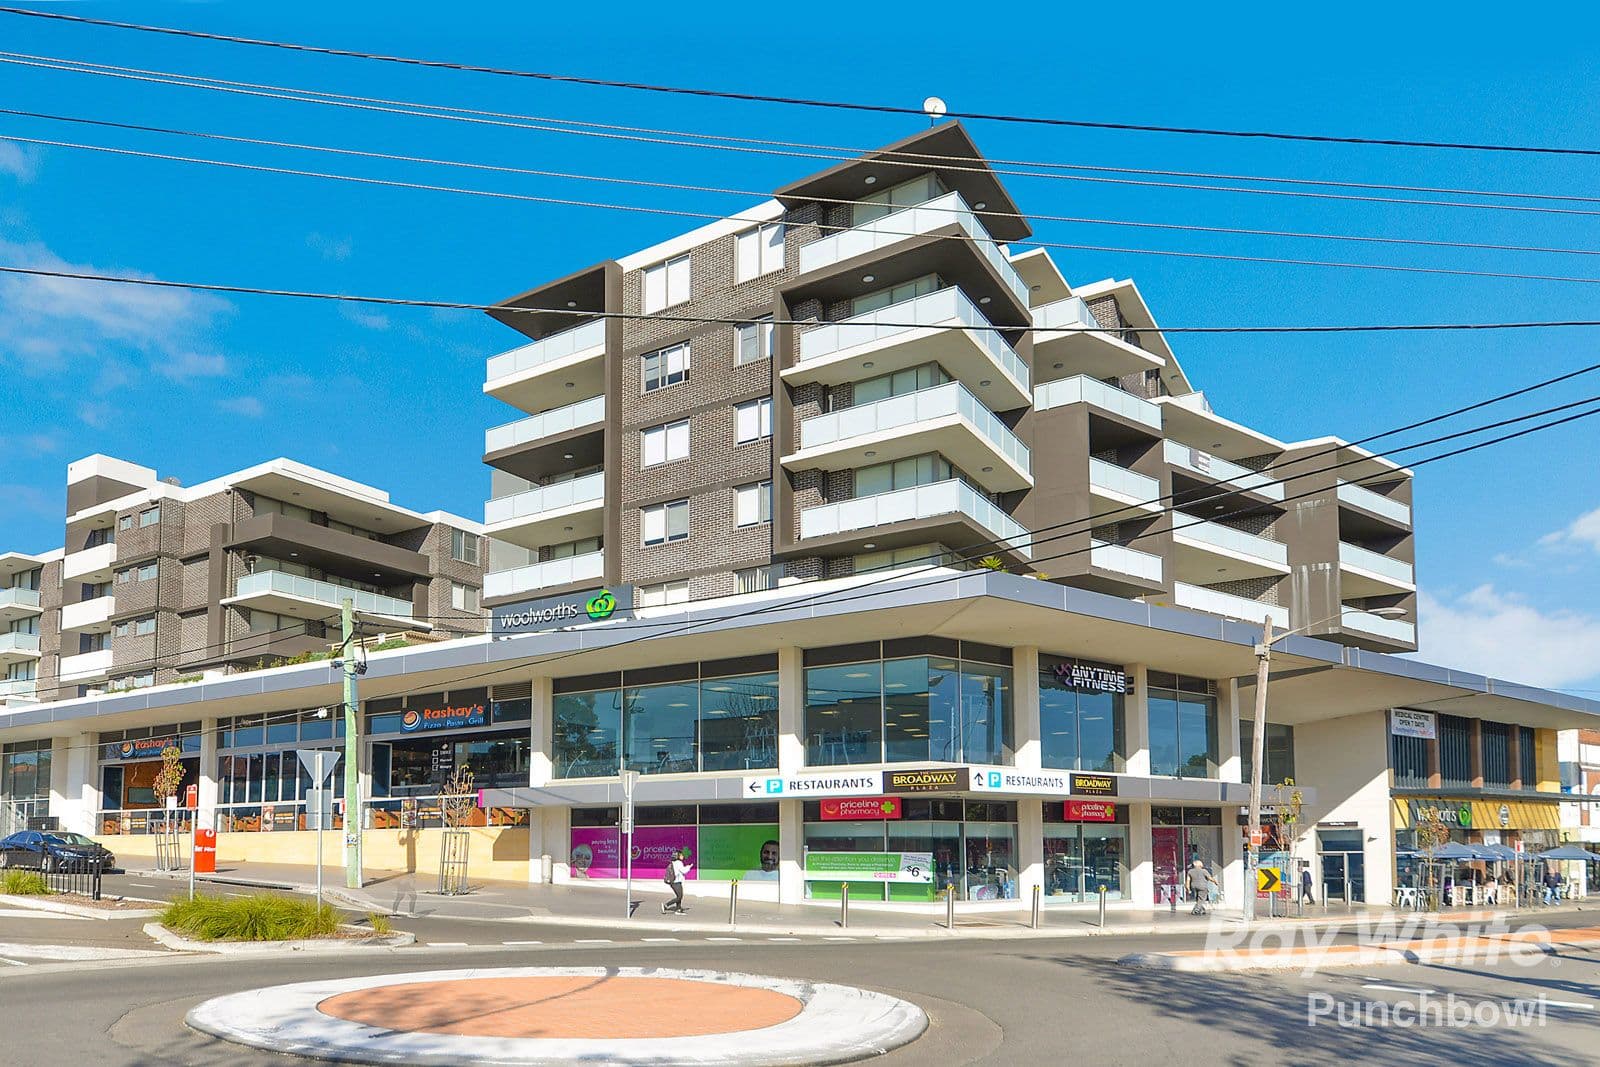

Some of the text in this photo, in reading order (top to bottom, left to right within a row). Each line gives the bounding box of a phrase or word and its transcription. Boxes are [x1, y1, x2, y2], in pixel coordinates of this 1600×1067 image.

[500, 602, 578, 627] woolworths
[1071, 665, 1125, 683] ANYTIME
[1073, 678, 1125, 693] FITNESS
[423, 703, 484, 719] Rashay's
[446, 719, 464, 727] Pasta
[468, 716, 484, 725] Grill
[789, 777, 874, 791] RESTAURANTS
[893, 773, 957, 785] BROADWAY
[1006, 775, 1064, 788] RESTAURANTS
[1075, 779, 1112, 788] BROADWAY
[840, 801, 879, 810] priceline
[840, 808, 880, 816] pharmacy
[906, 865, 920, 877] $6
